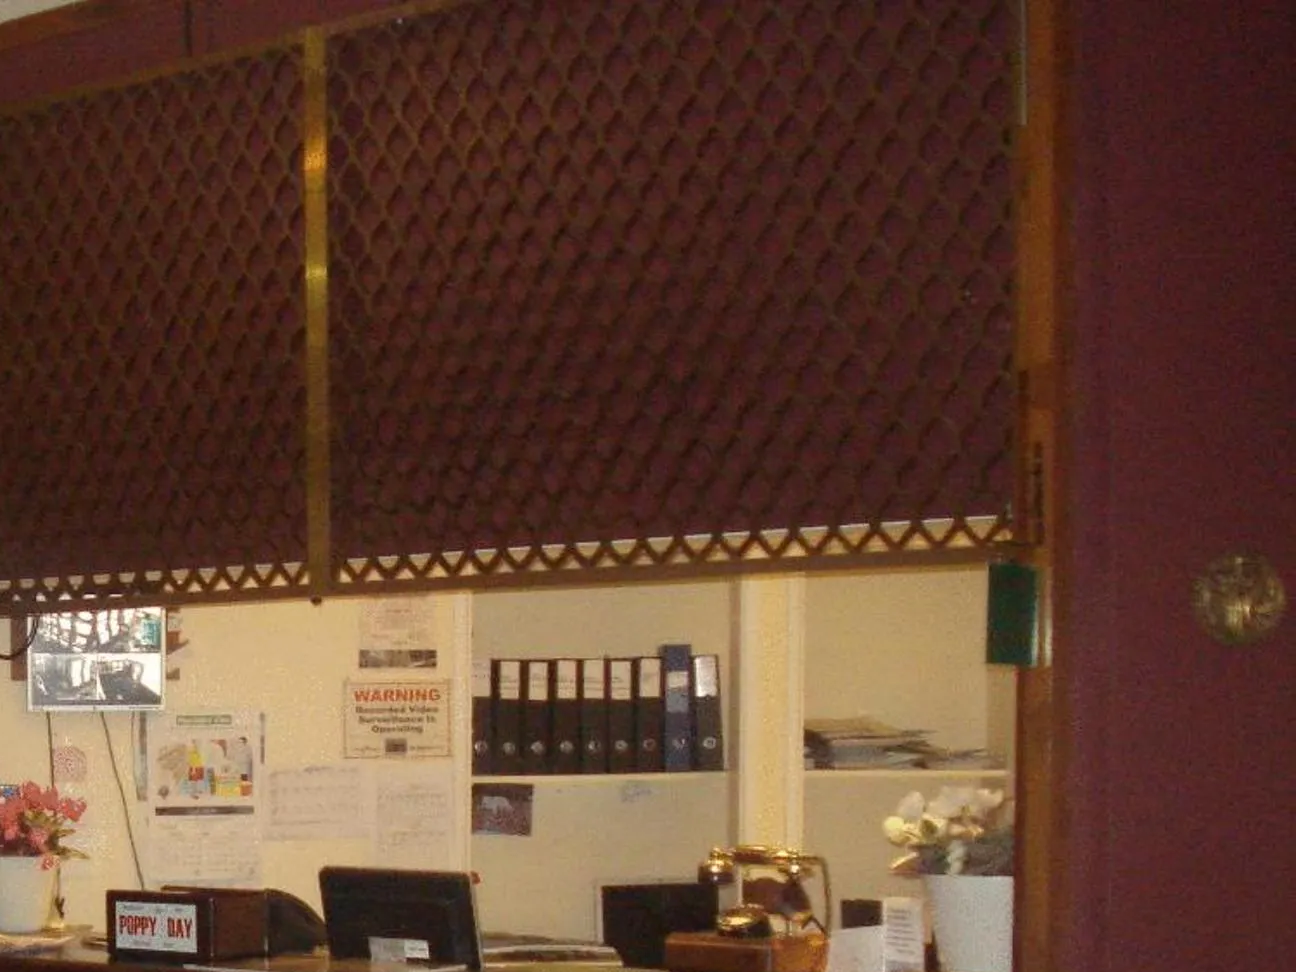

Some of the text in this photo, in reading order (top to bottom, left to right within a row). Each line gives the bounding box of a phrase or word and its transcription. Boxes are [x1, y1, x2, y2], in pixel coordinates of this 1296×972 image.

[354, 688, 441, 702] WARNING
[119, 915, 193, 938] POPPY DAY
